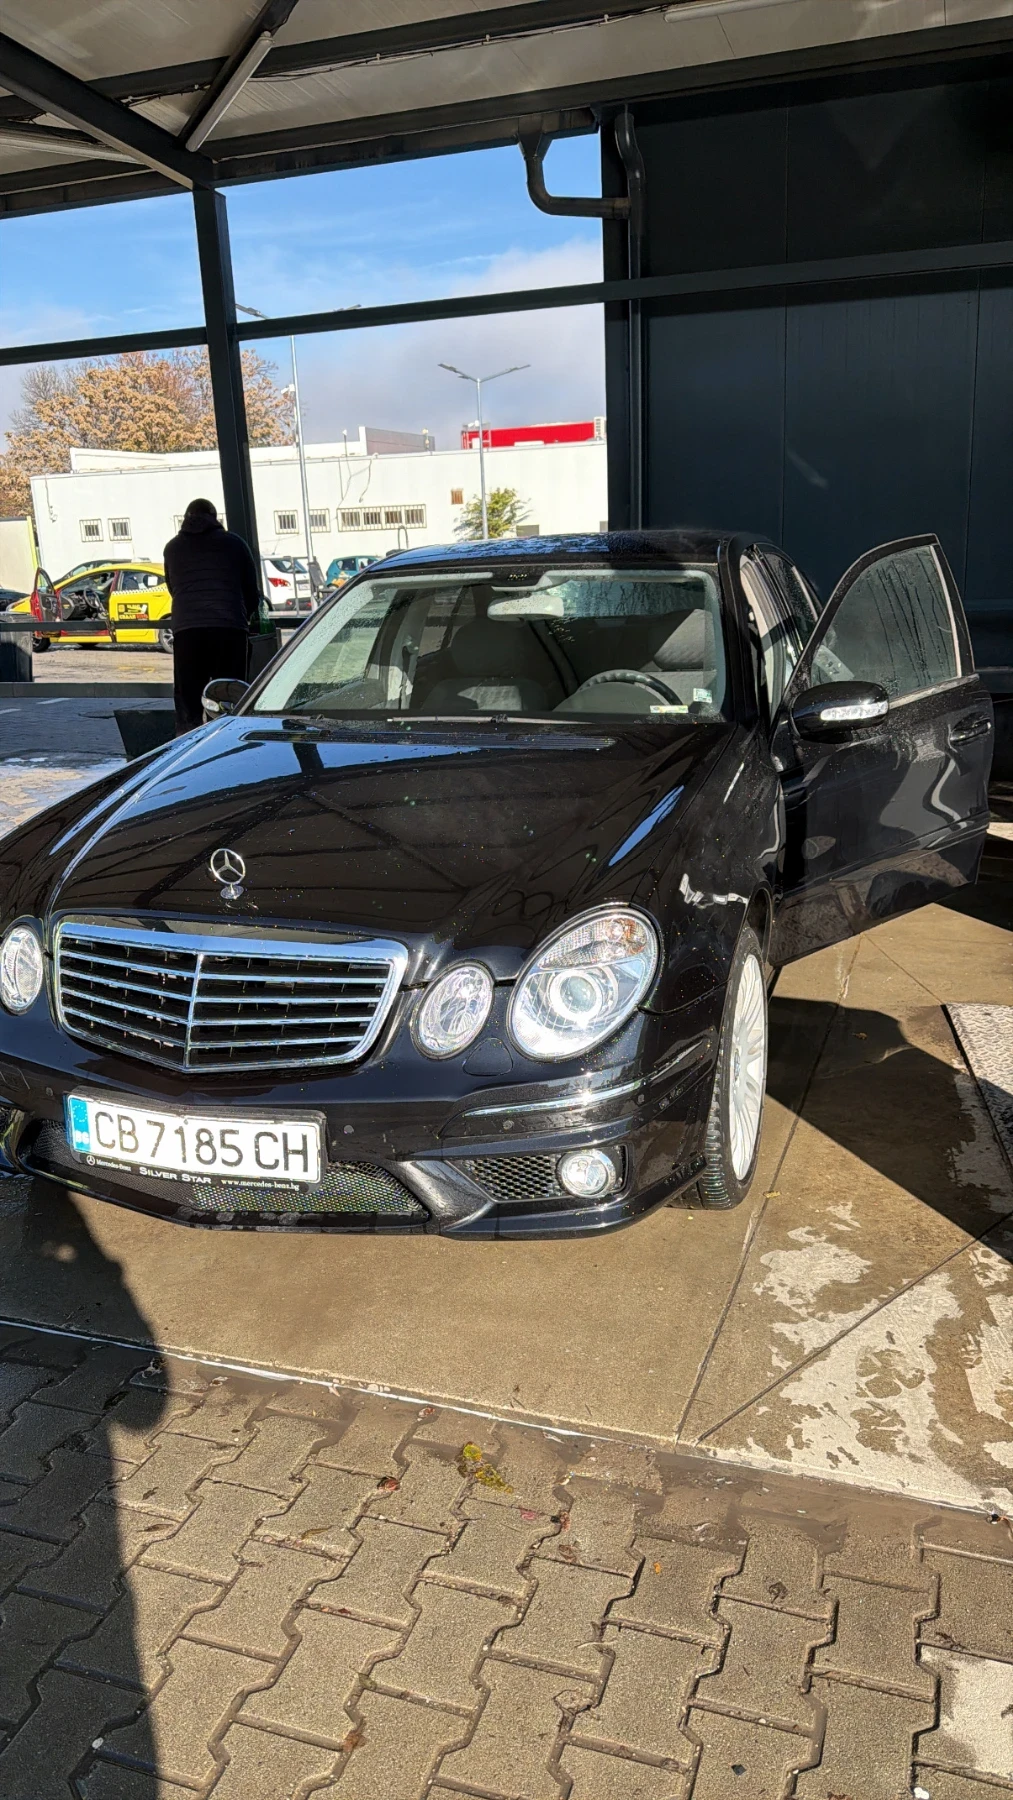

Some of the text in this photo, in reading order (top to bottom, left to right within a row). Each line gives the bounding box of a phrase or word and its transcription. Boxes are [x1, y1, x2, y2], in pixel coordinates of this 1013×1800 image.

[75, 1130, 91, 1145] BG
[95, 1111, 309, 1173] CB 7185 CH
[96, 1159, 131, 1171] Mercedes-Benz
[139, 1166, 212, 1185] SILVER STAR
[220, 1179, 300, 1192] www.mercedes-benz.bg
